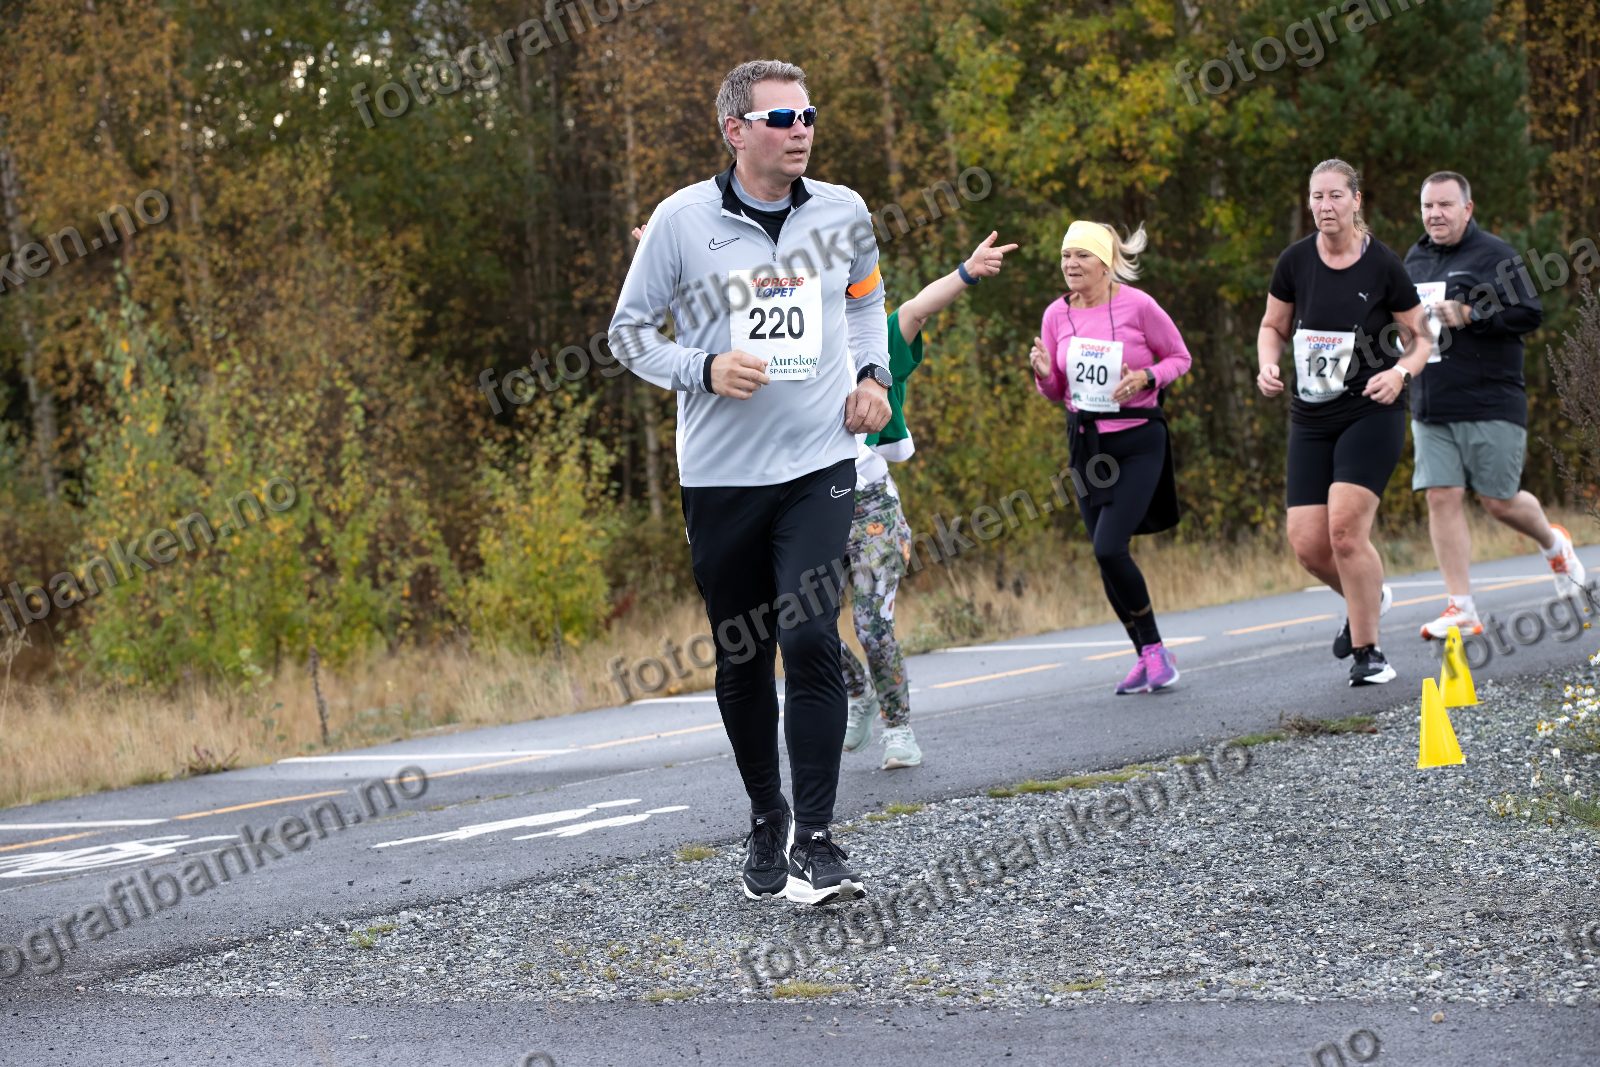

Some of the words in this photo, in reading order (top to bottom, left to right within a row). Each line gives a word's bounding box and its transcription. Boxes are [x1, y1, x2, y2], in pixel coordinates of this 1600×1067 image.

[753, 276, 804, 288] NORGES
[756, 287, 796, 298] LØPET
[749, 306, 805, 340] 220
[1306, 335, 1343, 344] NORGES
[1080, 343, 1112, 353] NORGES
[1308, 343, 1336, 351] LØPET
[769, 354, 818, 368] Aurskog
[1305, 356, 1341, 378] 127
[1075, 361, 1108, 386] 240
